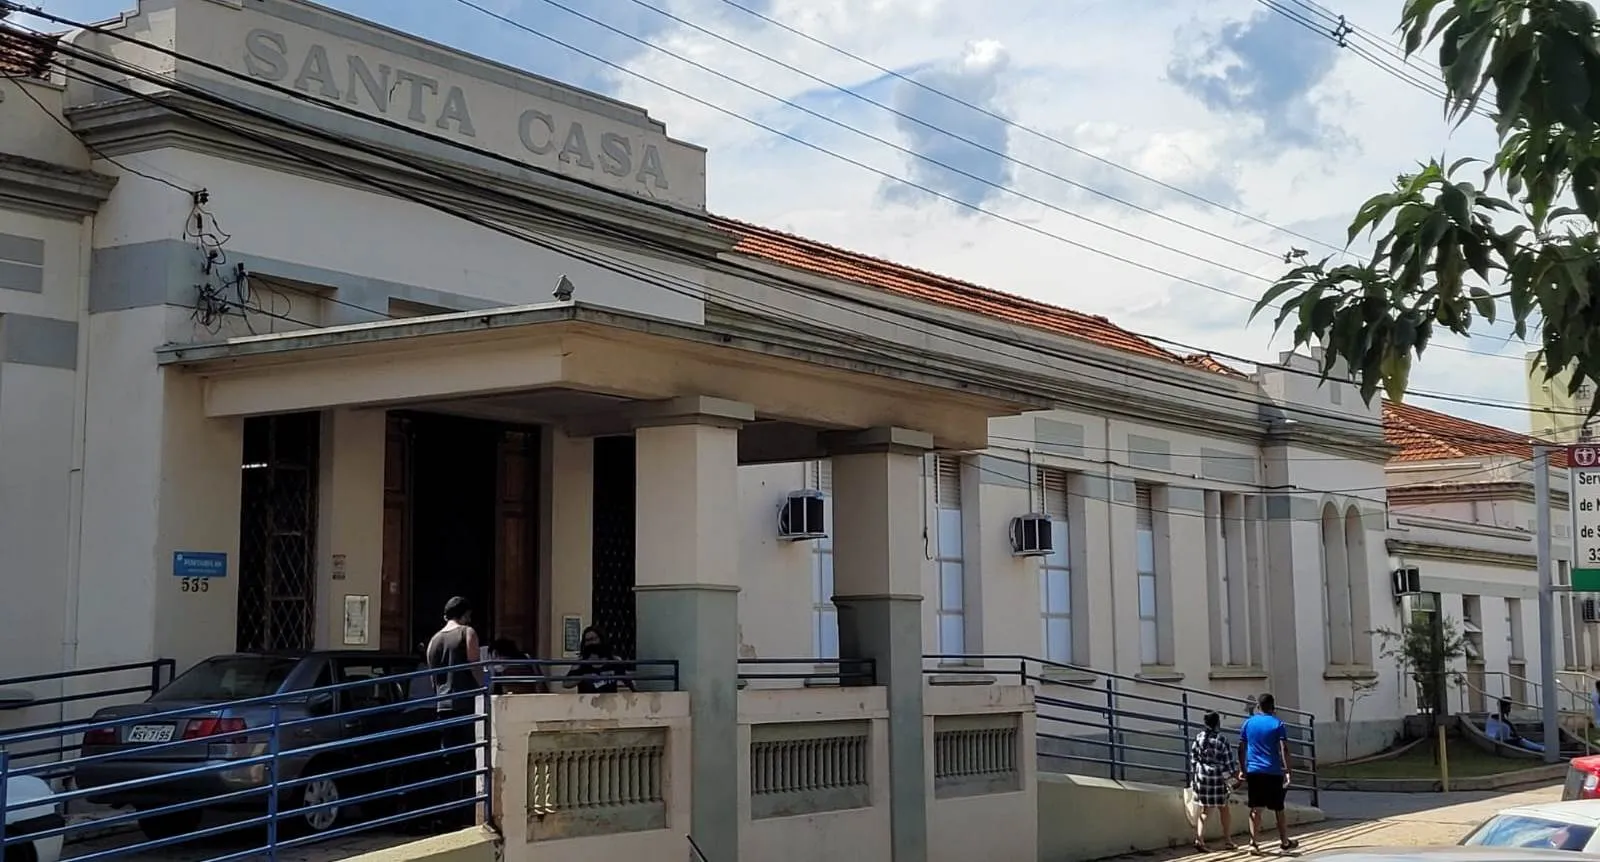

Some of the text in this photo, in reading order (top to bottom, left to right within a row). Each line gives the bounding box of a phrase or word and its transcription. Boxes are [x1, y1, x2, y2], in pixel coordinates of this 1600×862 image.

[243, 28, 668, 189] SANTA CASA
[1580, 498, 1593, 511] de
[1581, 525, 1594, 538] de
[181, 577, 209, 592] 535
